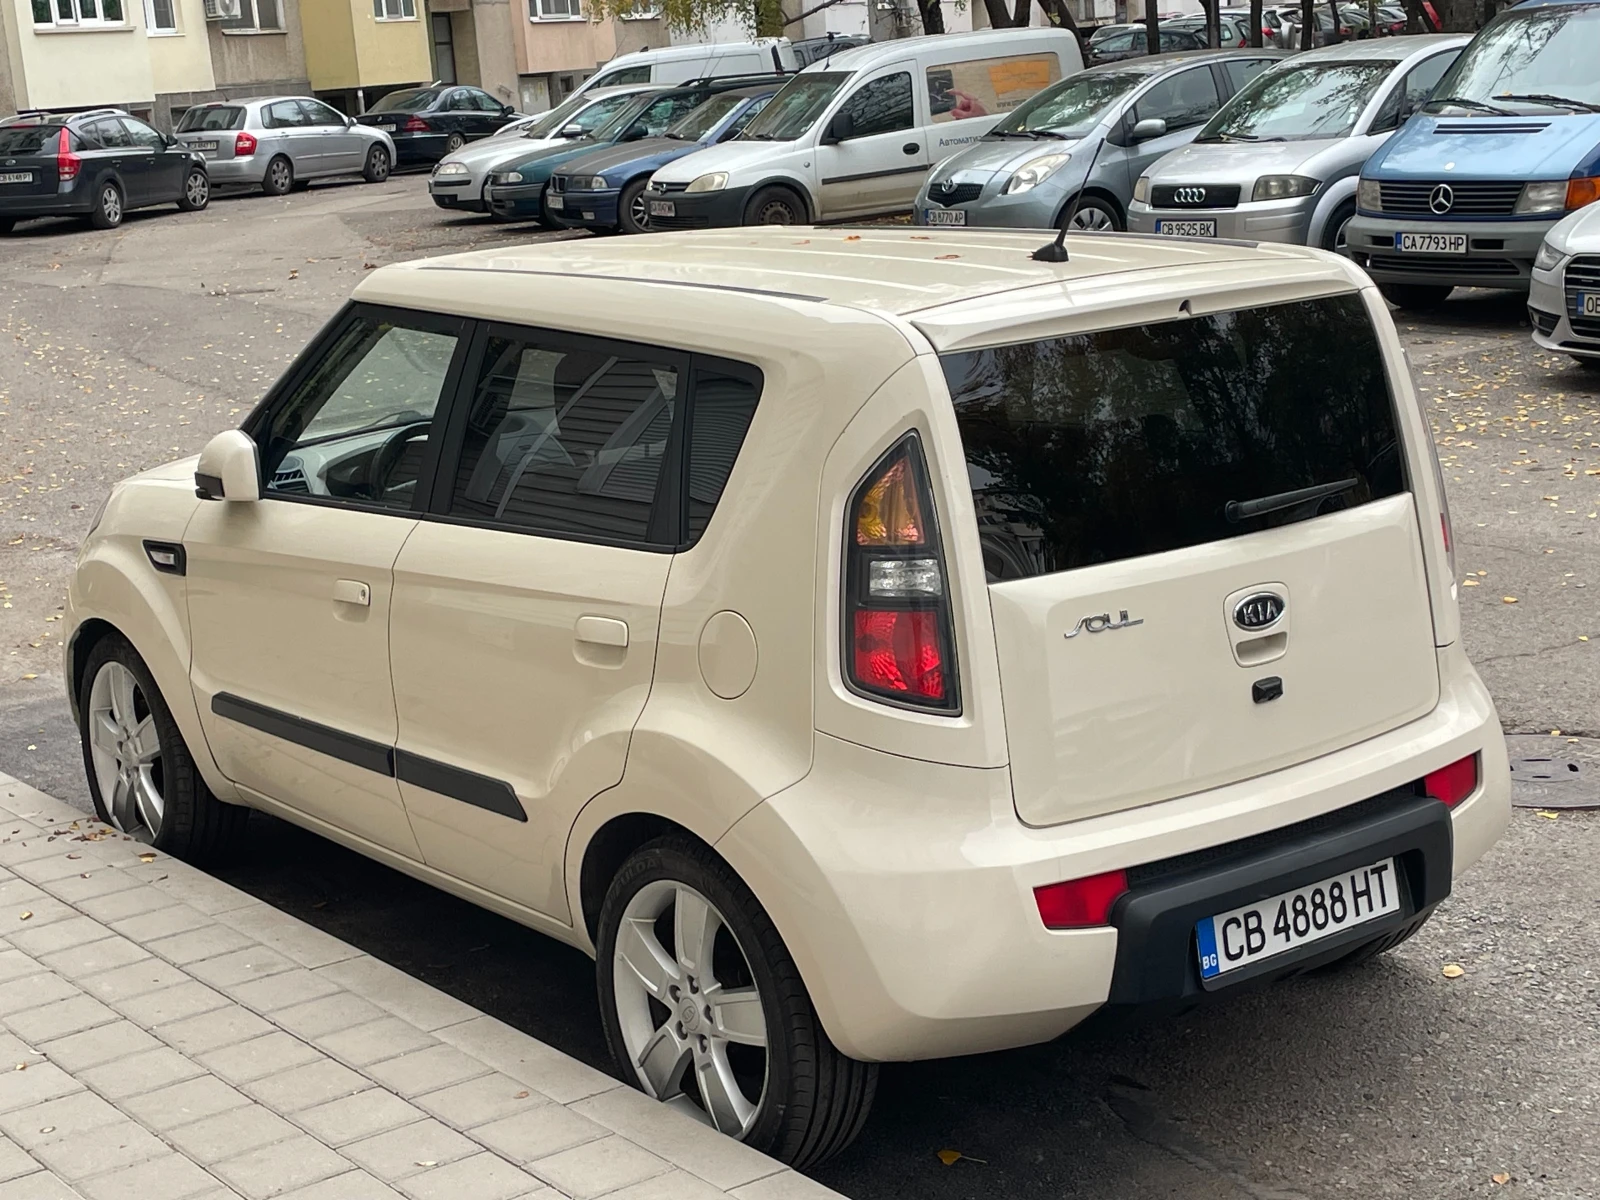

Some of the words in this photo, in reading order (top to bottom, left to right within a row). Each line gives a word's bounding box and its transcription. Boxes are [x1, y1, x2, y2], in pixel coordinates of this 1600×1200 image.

[1162, 222, 1174, 235] CB
[1175, 223, 1198, 236] 9525
[1199, 223, 1212, 236] BK
[1403, 235, 1417, 250] CA
[1419, 235, 1447, 251] 7793
[1448, 236, 1465, 251] HP
[1242, 600, 1278, 624] KIA
[1222, 910, 1266, 962] CB
[1273, 881, 1348, 943] 4888
[1350, 863, 1389, 918] HT
[1202, 953, 1217, 970] BG
